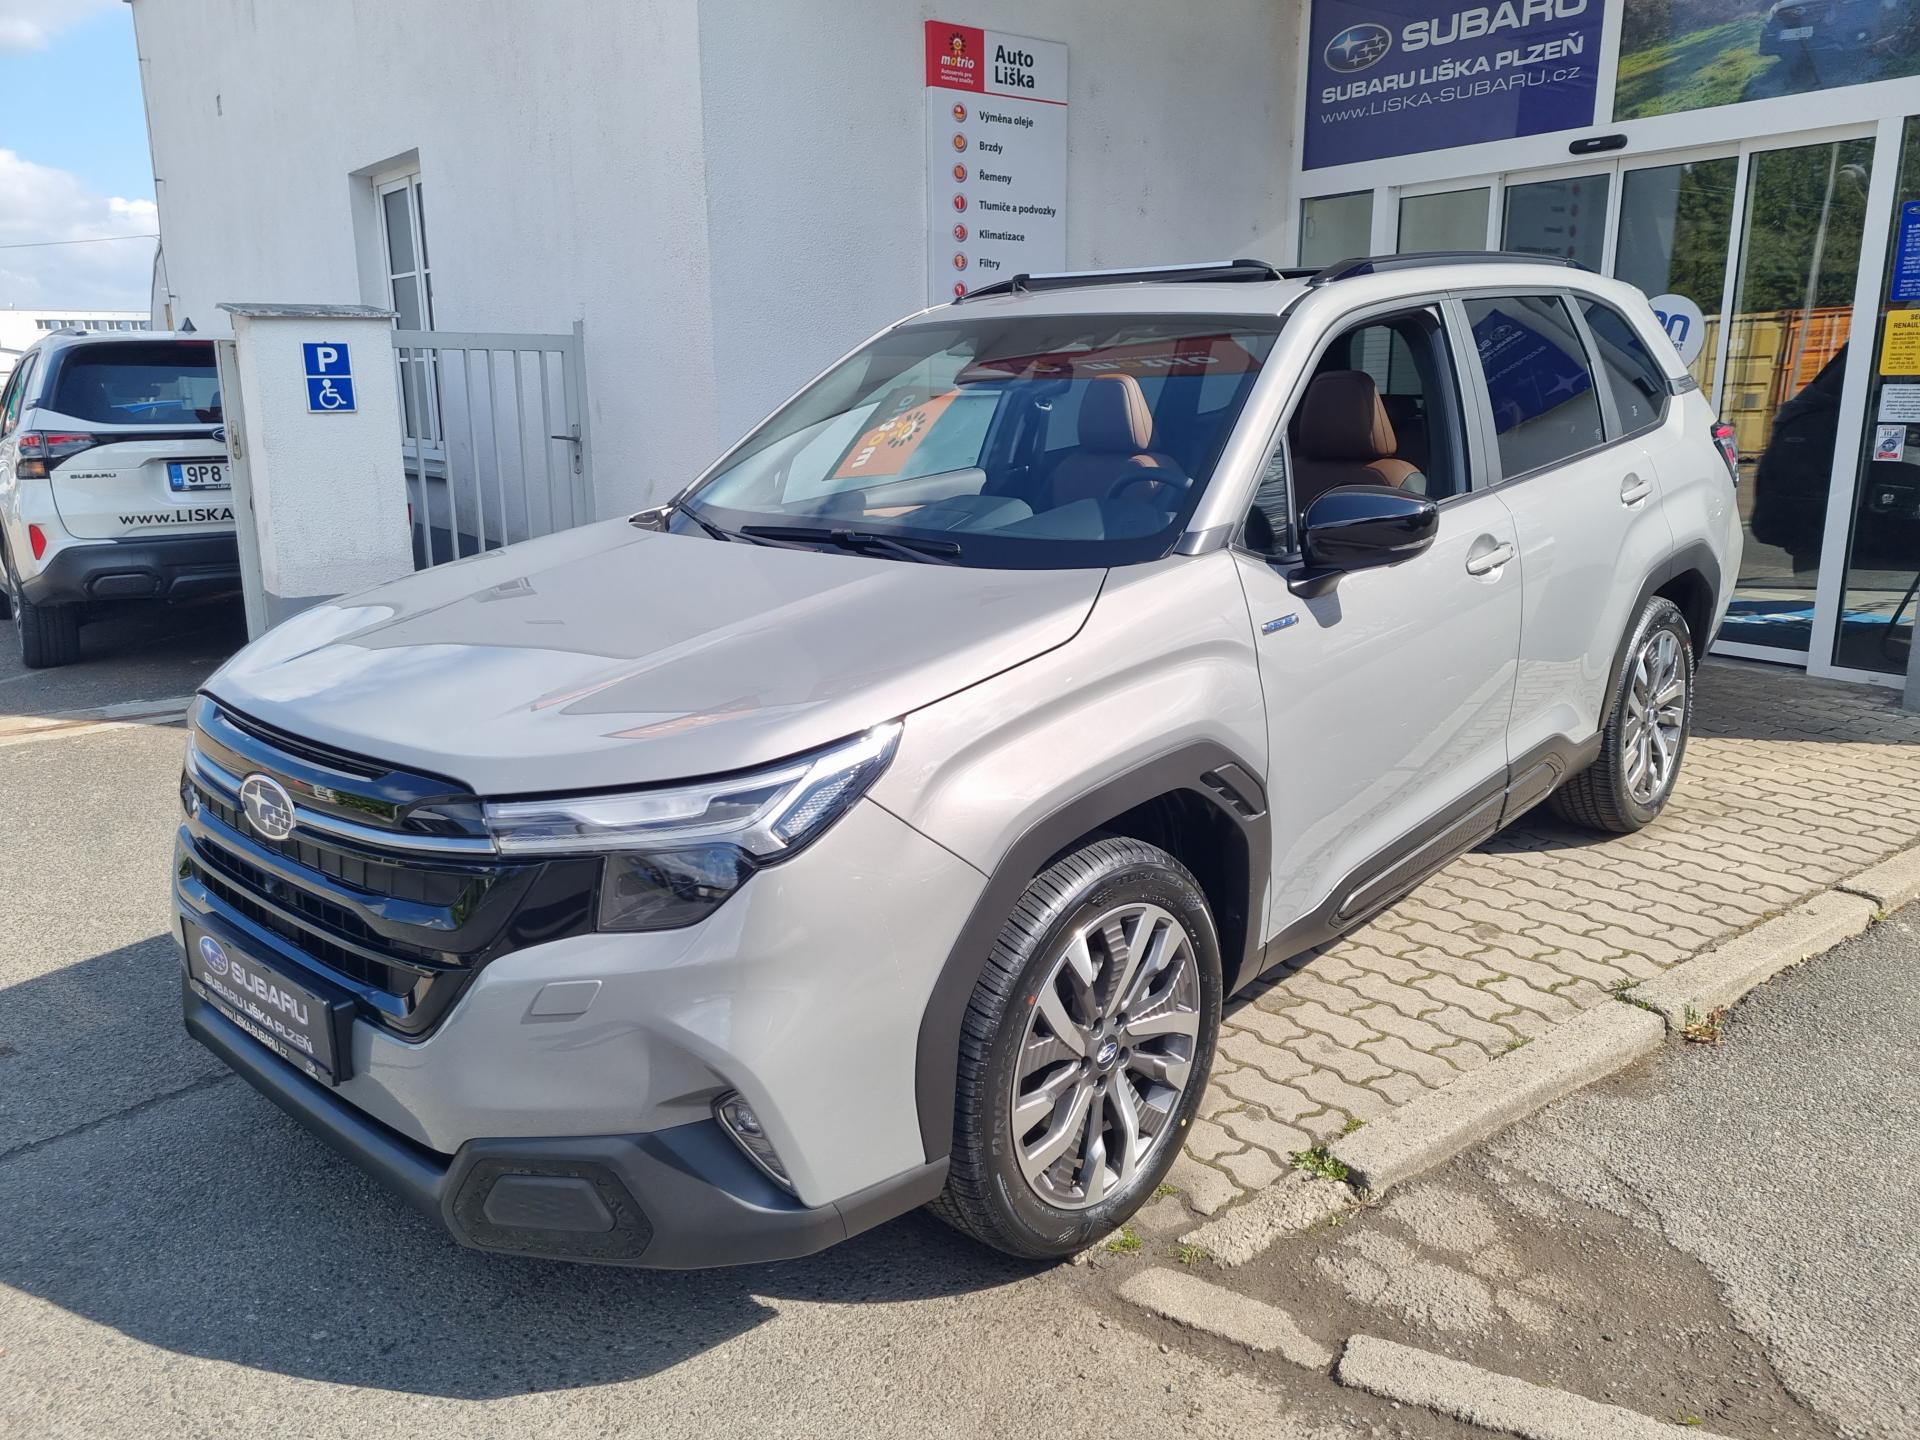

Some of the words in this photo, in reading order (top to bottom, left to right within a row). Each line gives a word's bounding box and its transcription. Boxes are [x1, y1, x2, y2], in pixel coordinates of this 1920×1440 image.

[1401, 0, 1588, 53] SUBARU
[940, 55, 975, 69] motrio
[995, 45, 1034, 68] Auto
[1322, 70, 1416, 104] SUBARU
[1420, 58, 1491, 85] LIŠKA
[1495, 31, 1584, 71] PLZEŇ
[995, 65, 1035, 89] Liška
[979, 111, 1012, 123] Výměna
[1014, 116, 1034, 128] oleje
[979, 141, 1003, 155] Brzdy
[979, 169, 1012, 185] Řemeny
[979, 200, 1011, 212] Tlumiče
[1019, 205, 1056, 218] podvozky
[979, 230, 1025, 241] Klimatizace
[979, 258, 1000, 270] Filtry
[316, 347, 338, 373] P
[186, 465, 222, 483] 9P8
[231, 961, 309, 1025] SUBARU
[204, 971, 244, 1009] SUBARU
[244, 999, 271, 1029] LIŠKA
[275, 1020, 314, 1054] PLZEŇ
